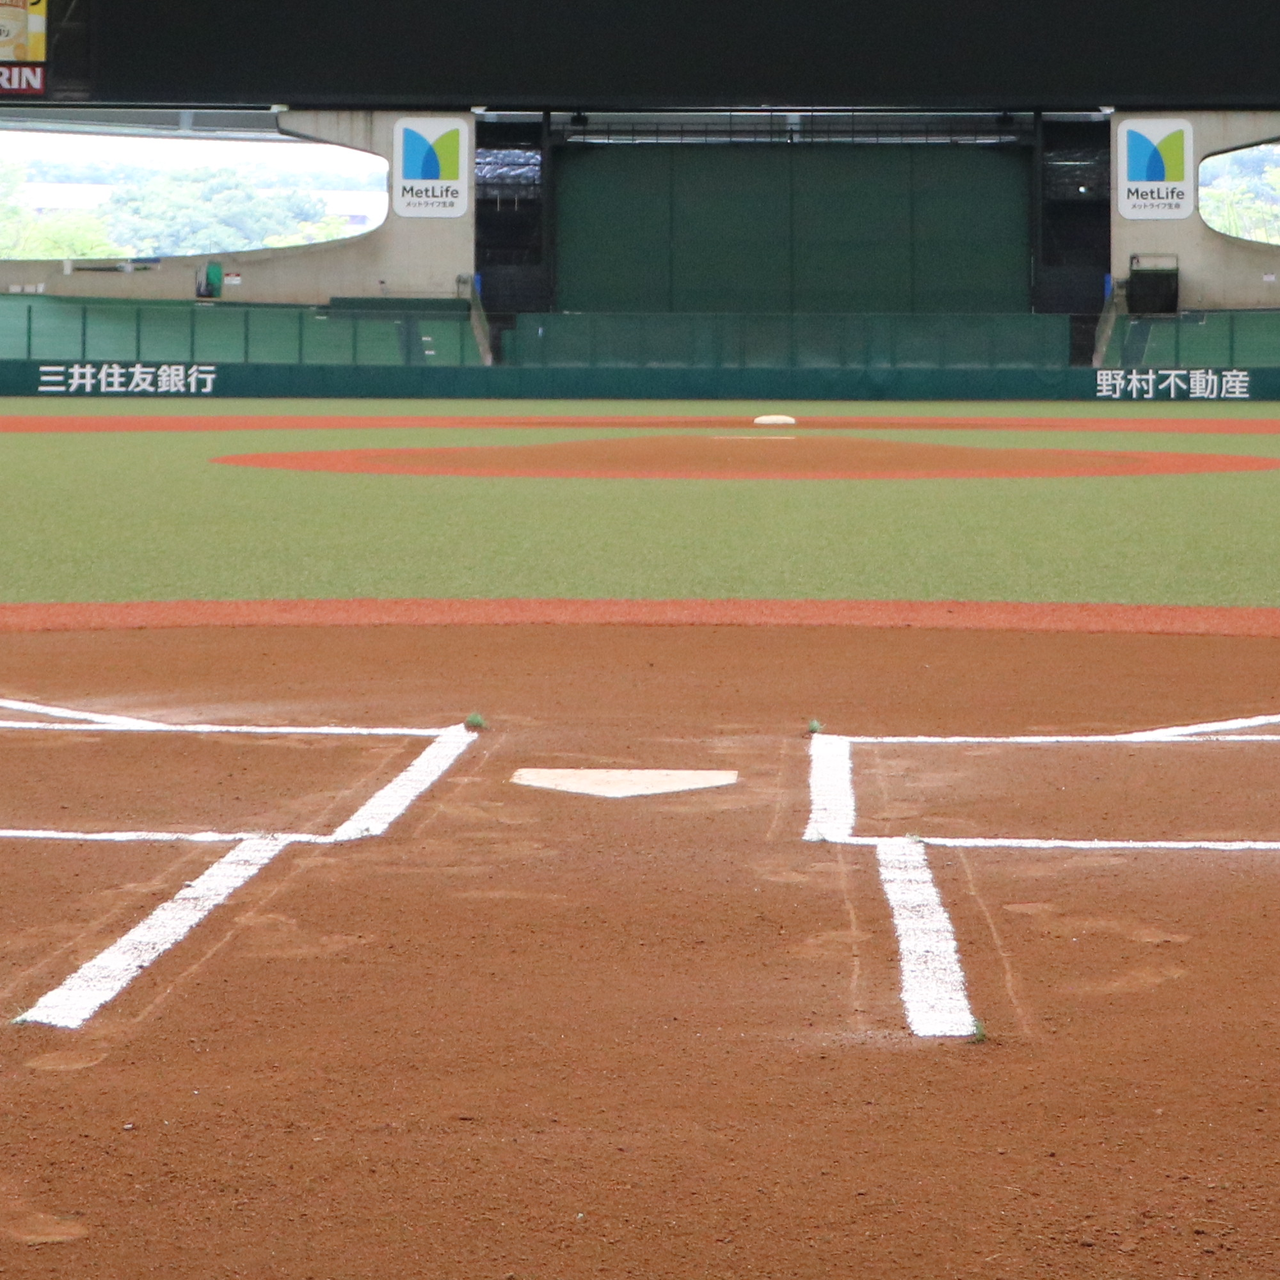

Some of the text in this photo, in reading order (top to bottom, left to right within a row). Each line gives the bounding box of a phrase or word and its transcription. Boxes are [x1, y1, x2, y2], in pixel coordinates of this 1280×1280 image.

[401, 185, 460, 199] MetLife
[1127, 187, 1185, 200] MetLife
[405, 200, 455, 208] メットライフ生命
[1131, 202, 1181, 210] メットライフ生命
[38, 364, 217, 393] 三井住友銀行
[1095, 368, 1250, 399] 野村不動産
